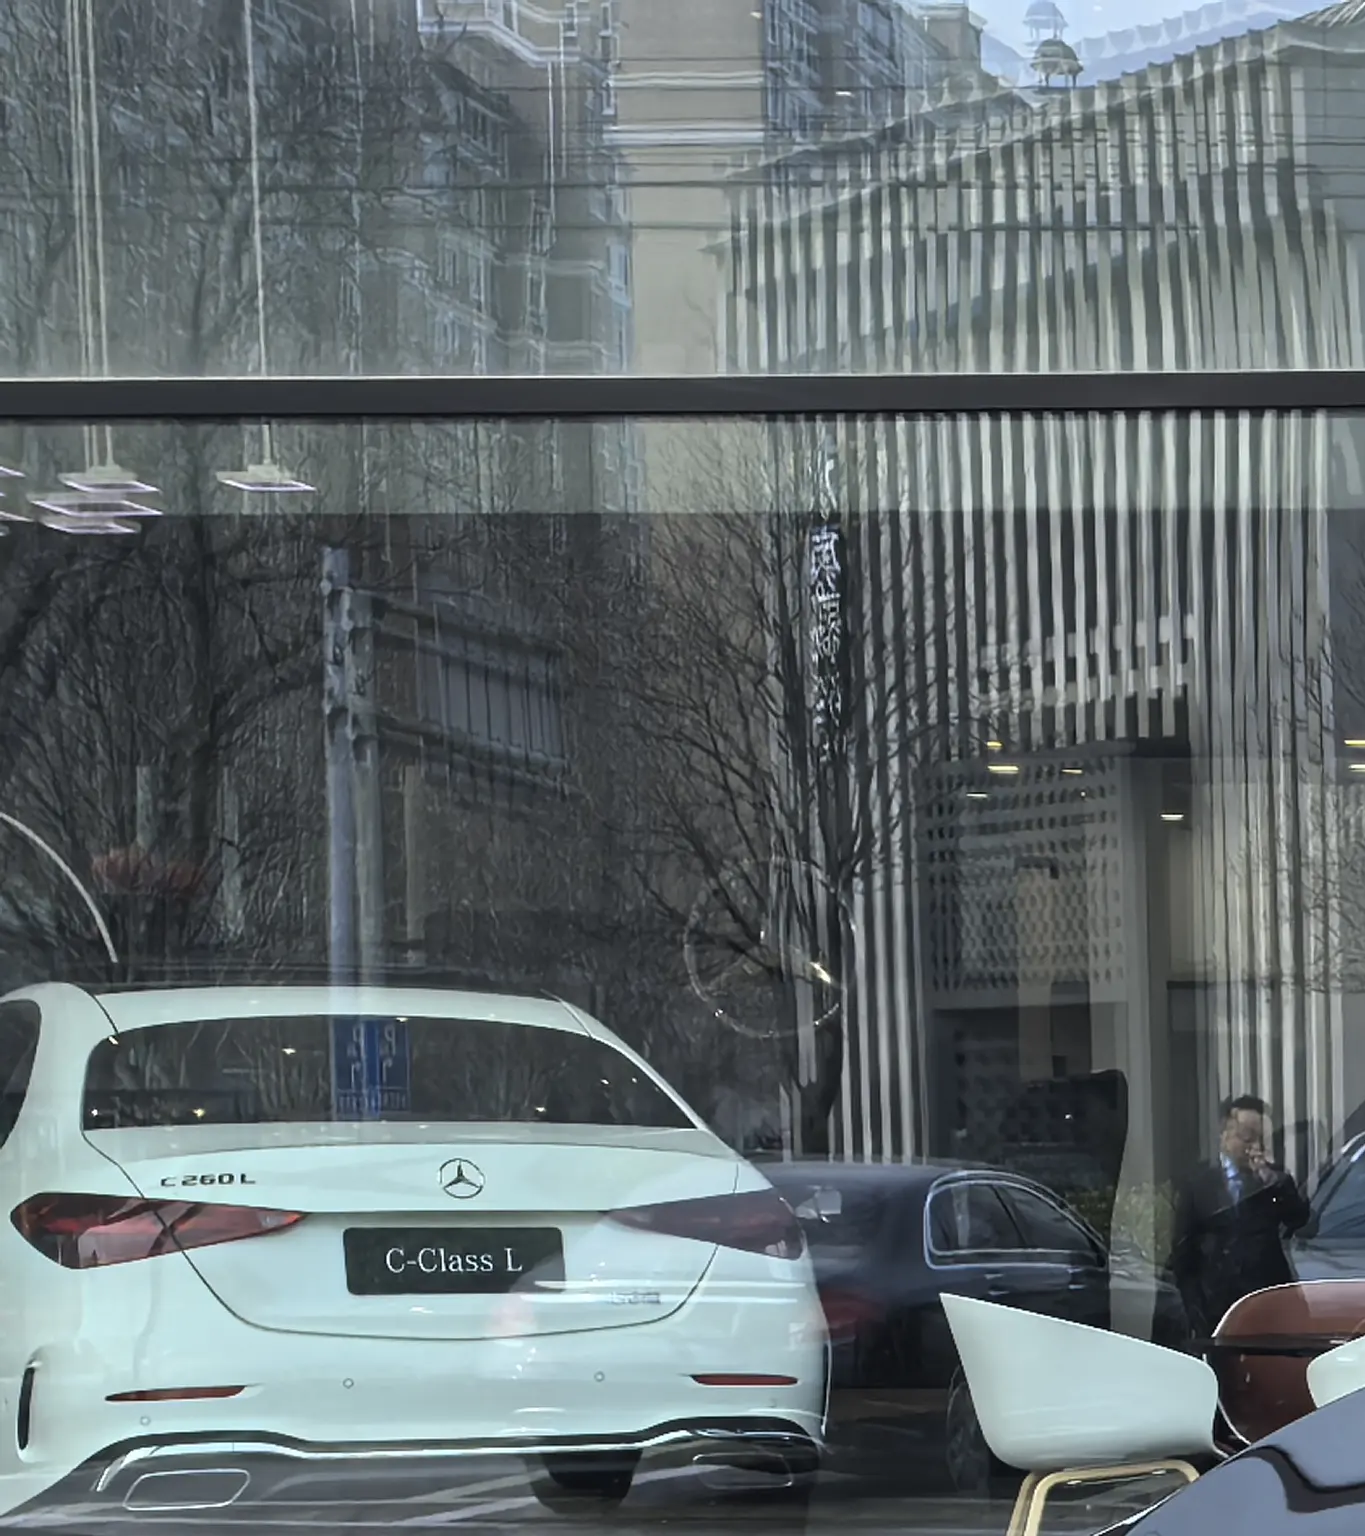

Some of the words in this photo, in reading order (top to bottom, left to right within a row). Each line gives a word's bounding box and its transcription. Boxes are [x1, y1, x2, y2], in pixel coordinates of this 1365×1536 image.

[181, 1173, 234, 1186] 260
[385, 1244, 494, 1275] C-Class
[505, 1245, 524, 1273] L
